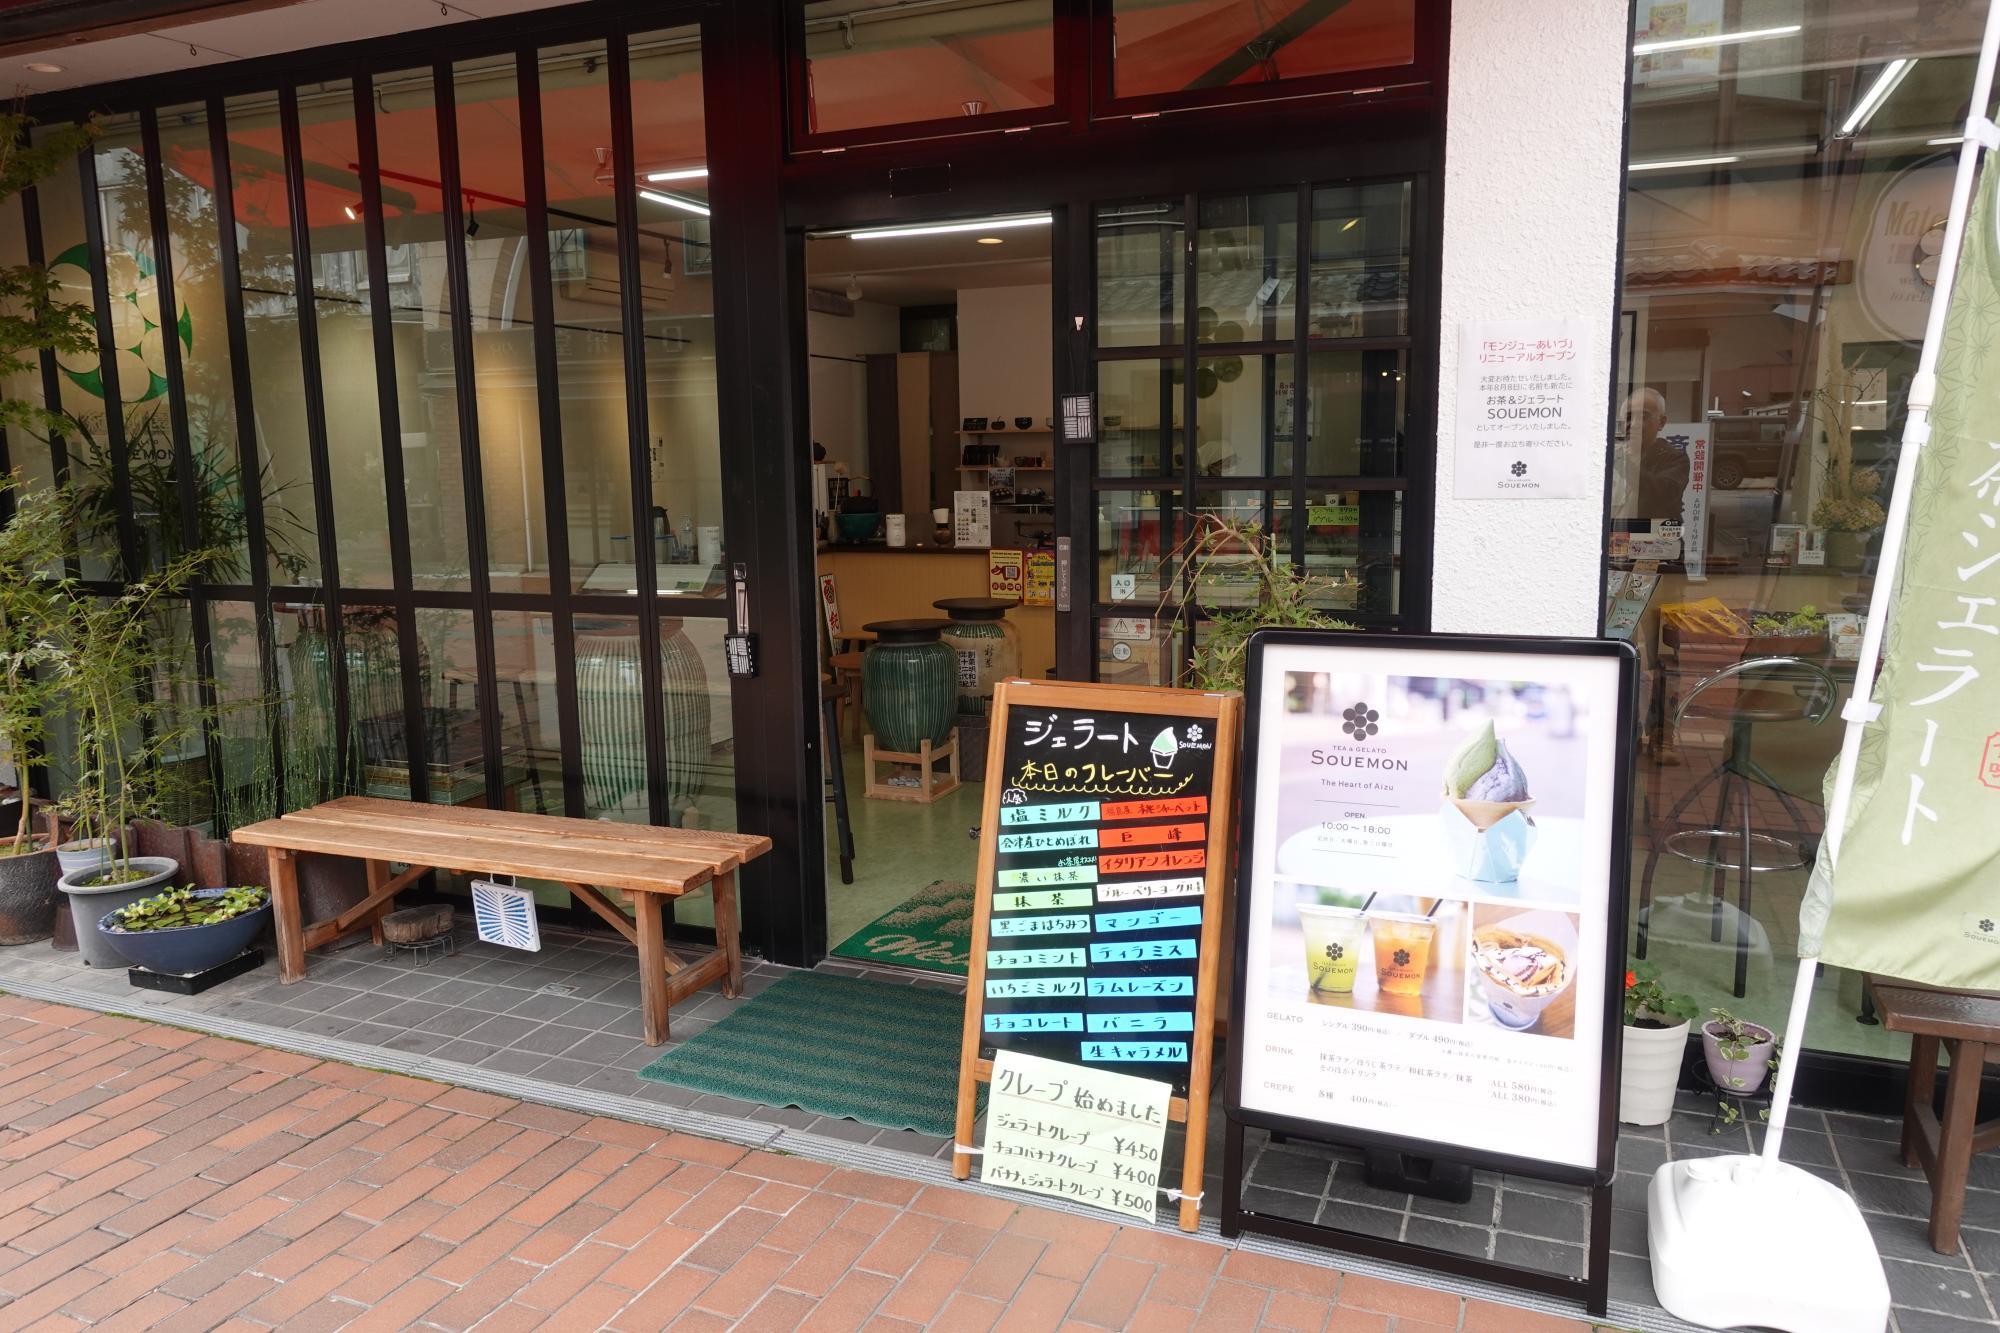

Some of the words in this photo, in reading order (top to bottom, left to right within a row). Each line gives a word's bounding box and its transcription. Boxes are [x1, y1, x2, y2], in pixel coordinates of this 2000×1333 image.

[1479, 351, 1576, 363] リニューアルオープン
[1487, 407, 1562, 419] SOUEMON
[1023, 713, 1140, 754] ジェラート
[1355, 746, 1387, 754] GELATO
[1311, 749, 1409, 772] SOUEMON
[1020, 760, 1175, 784] 本日のフレーバー
[1321, 778, 1337, 787] The
[1338, 780, 1362, 789] Heart
[1374, 783, 1395, 791] Aizu
[1009, 805, 1091, 823] 塩ミルク
[1321, 821, 1349, 831] 10:00
[1363, 826, 1391, 835] 18:00
[1001, 834, 1092, 849] 会津産ひとめぼれ
[1103, 852, 1204, 870] イタリアンオレンジ
[998, 918, 1089, 933] 黒ごまはちみつ
[1104, 911, 1182, 928] マンゴー
[993, 951, 1080, 965] チョコミント
[1098, 944, 1182, 959] ティラミス
[1312, 961, 1354, 974] SOUEMON
[992, 981, 1081, 994] いちごミルク
[1094, 980, 1184, 994] ラムレーズン
[991, 1016, 1073, 1029] チョコレート
[1102, 1016, 1168, 1030] バニラ
[1266, 1011, 1304, 1023] GELATO
[1089, 1045, 1183, 1060] 生キャラメル
[1265, 1044, 1294, 1056] DRINK
[1490, 1079, 1509, 1089] ALL
[1263, 1081, 1296, 1093] CREPE
[999, 1068, 1069, 1102] クレープ
[1074, 1086, 1161, 1124] 始めました
[1490, 1090, 1509, 1100] ALL
[996, 1113, 1091, 1143] ジェラートクレープ
[1113, 1136, 1159, 1162] ¥450
[992, 1141, 1098, 1174] チョコバナナクレープ
[1112, 1162, 1157, 1188] ¥400
[1111, 1188, 1153, 1213] ¥500
